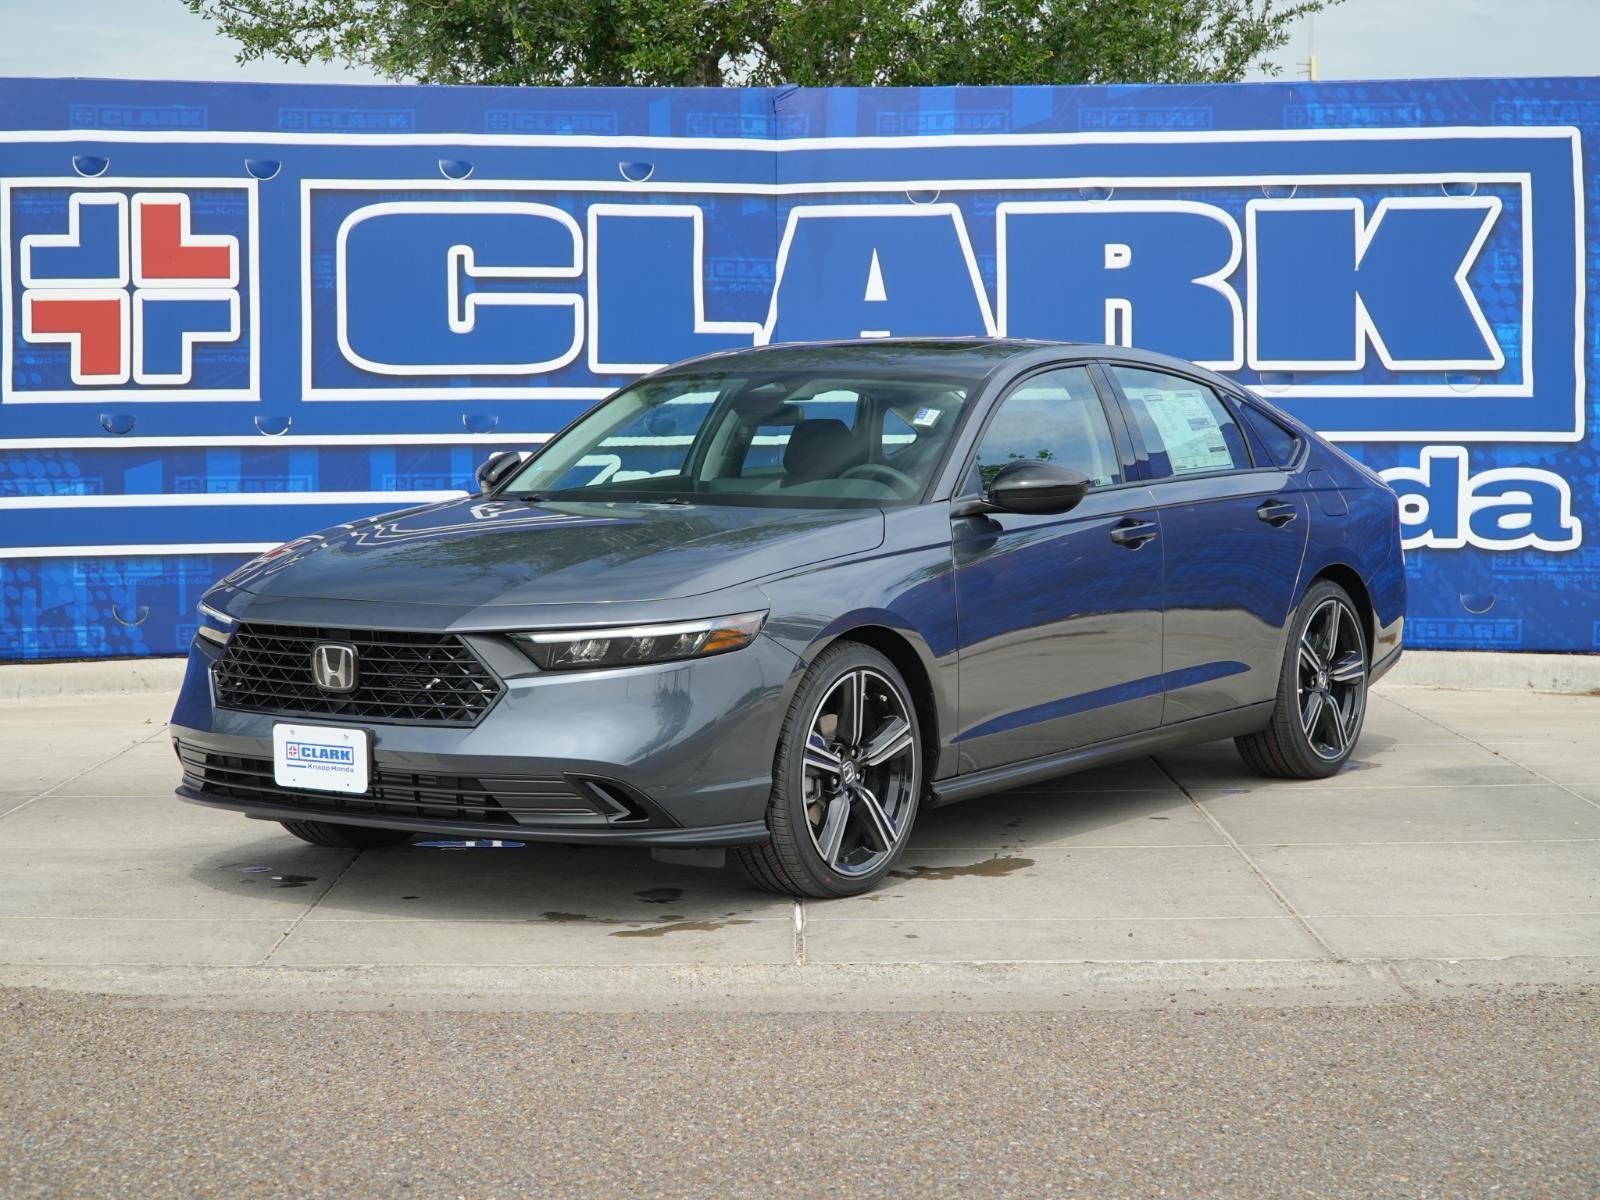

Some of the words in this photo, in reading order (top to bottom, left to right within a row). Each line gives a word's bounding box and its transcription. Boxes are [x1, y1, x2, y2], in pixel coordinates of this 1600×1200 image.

[102, 110, 200, 126] CLARK
[310, 112, 409, 129] CLARK
[1110, 111, 1208, 127] CLARK
[337, 196, 1504, 375] CLARK
[1416, 623, 1514, 638] CLARK
[301, 747, 350, 760] CLARK
[307, 763, 330, 771] Knapp
[331, 765, 354, 773] Honda
